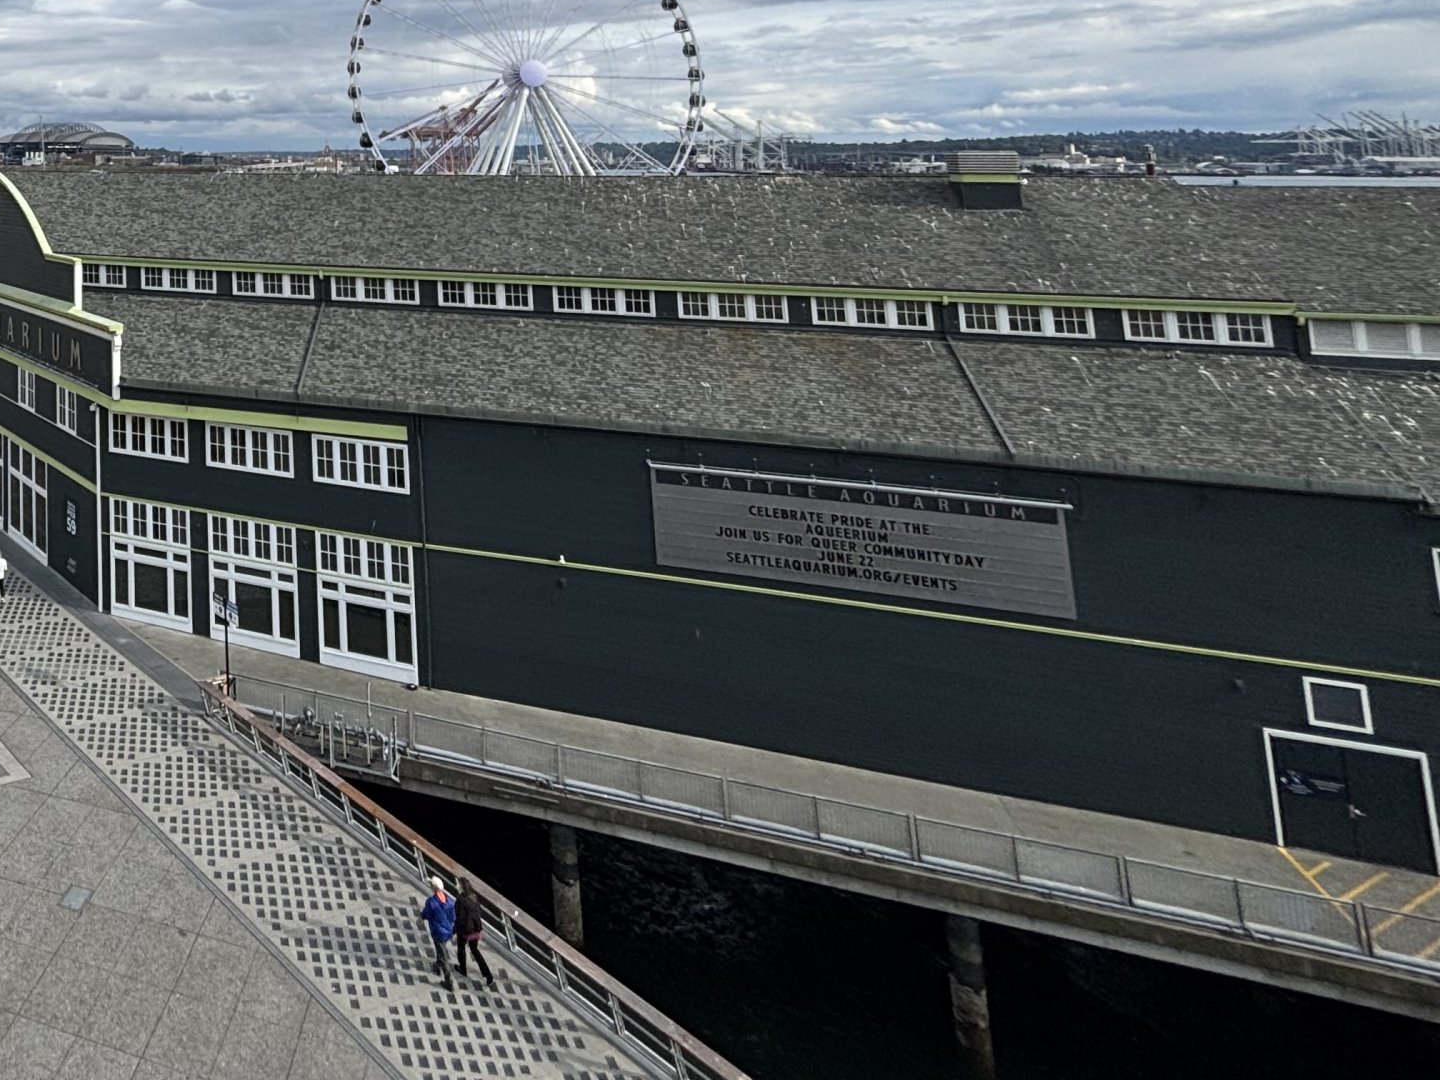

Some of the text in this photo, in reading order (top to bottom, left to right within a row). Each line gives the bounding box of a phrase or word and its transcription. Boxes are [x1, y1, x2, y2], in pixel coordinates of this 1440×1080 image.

[681, 473, 1026, 520] SEATTLE AQUARIUM
[67, 517, 76, 535] 59
[748, 505, 930, 536] CELEBRATE PRIDE AT THE
[805, 525, 889, 543] AQUEERIUM
[715, 526, 984, 568] JOIN US FOR QUEER COMMUNITY DAY
[817, 550, 874, 567] JUNE 22
[726, 551, 958, 591] SEATTLEAQUARIUM.ORG/EVENTS
